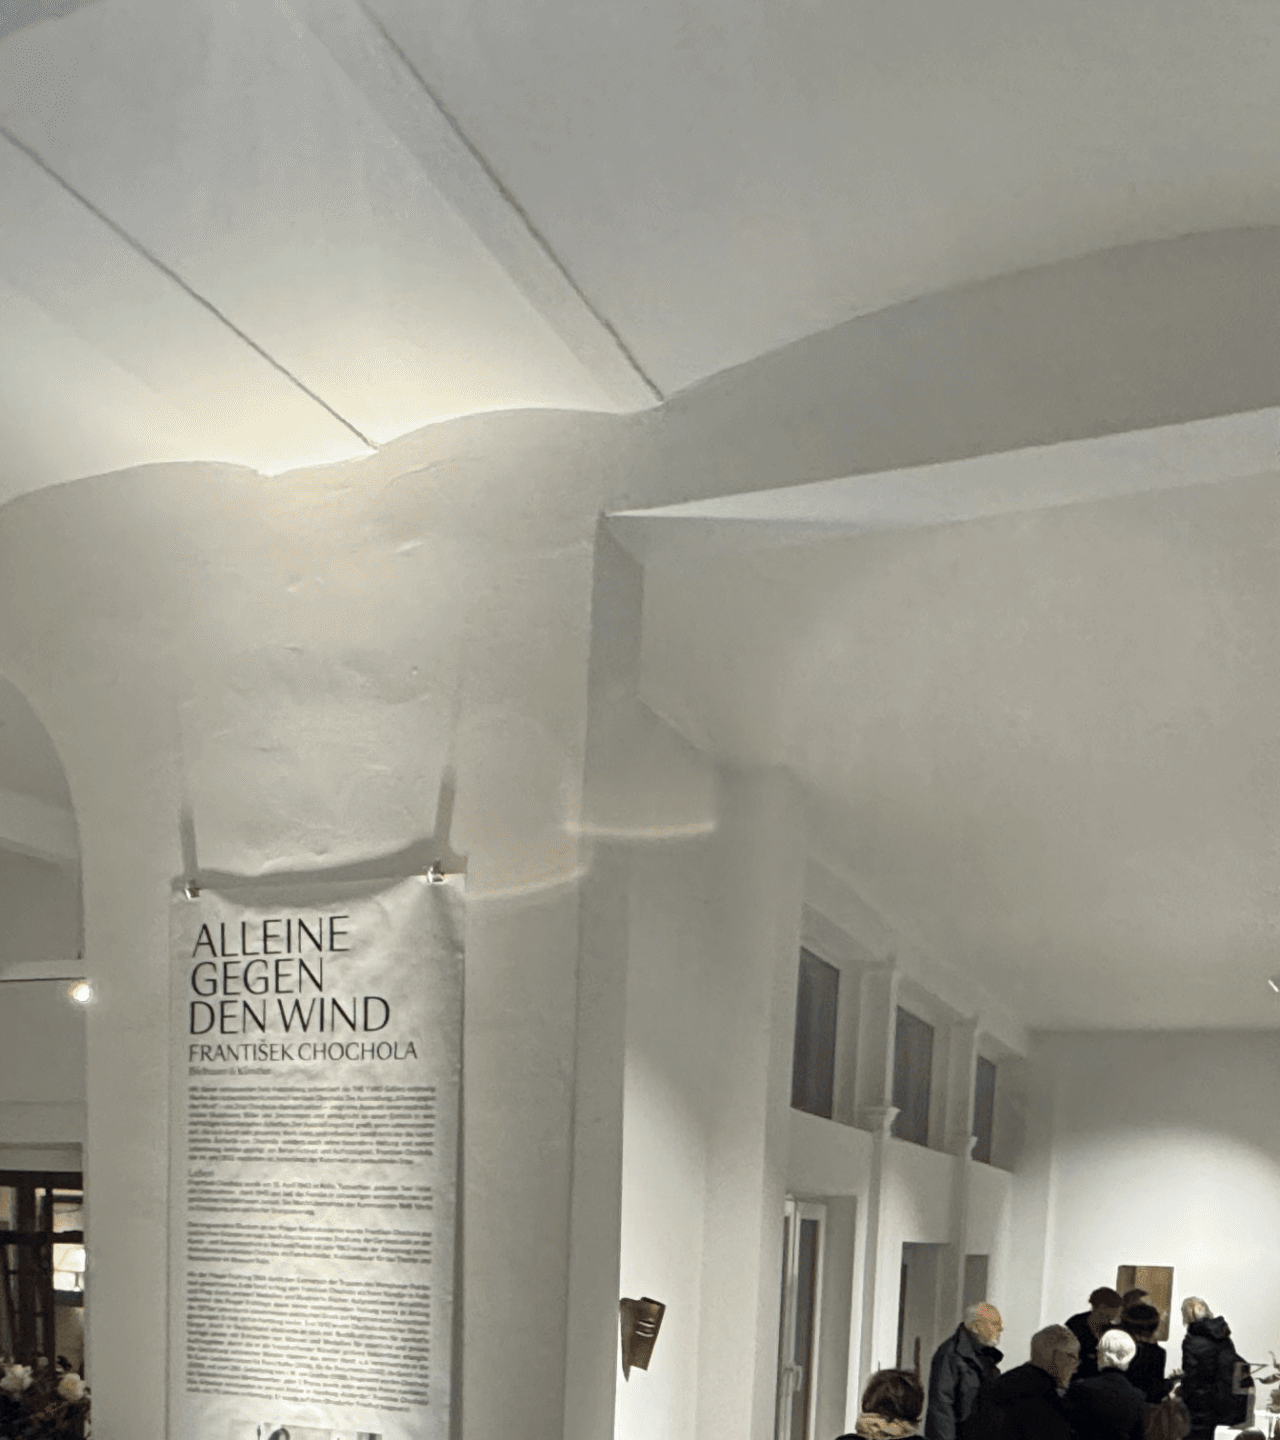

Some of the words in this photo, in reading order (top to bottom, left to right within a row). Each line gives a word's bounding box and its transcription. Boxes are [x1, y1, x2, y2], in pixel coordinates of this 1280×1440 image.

[192, 915, 351, 958] ALLEINE
[191, 957, 324, 997] GEGEN
[189, 999, 267, 1035] DEN
[277, 996, 391, 1034] WIND
[188, 1039, 295, 1063] FRANTIŠEK
[298, 1041, 418, 1061] CHOCHOLA
